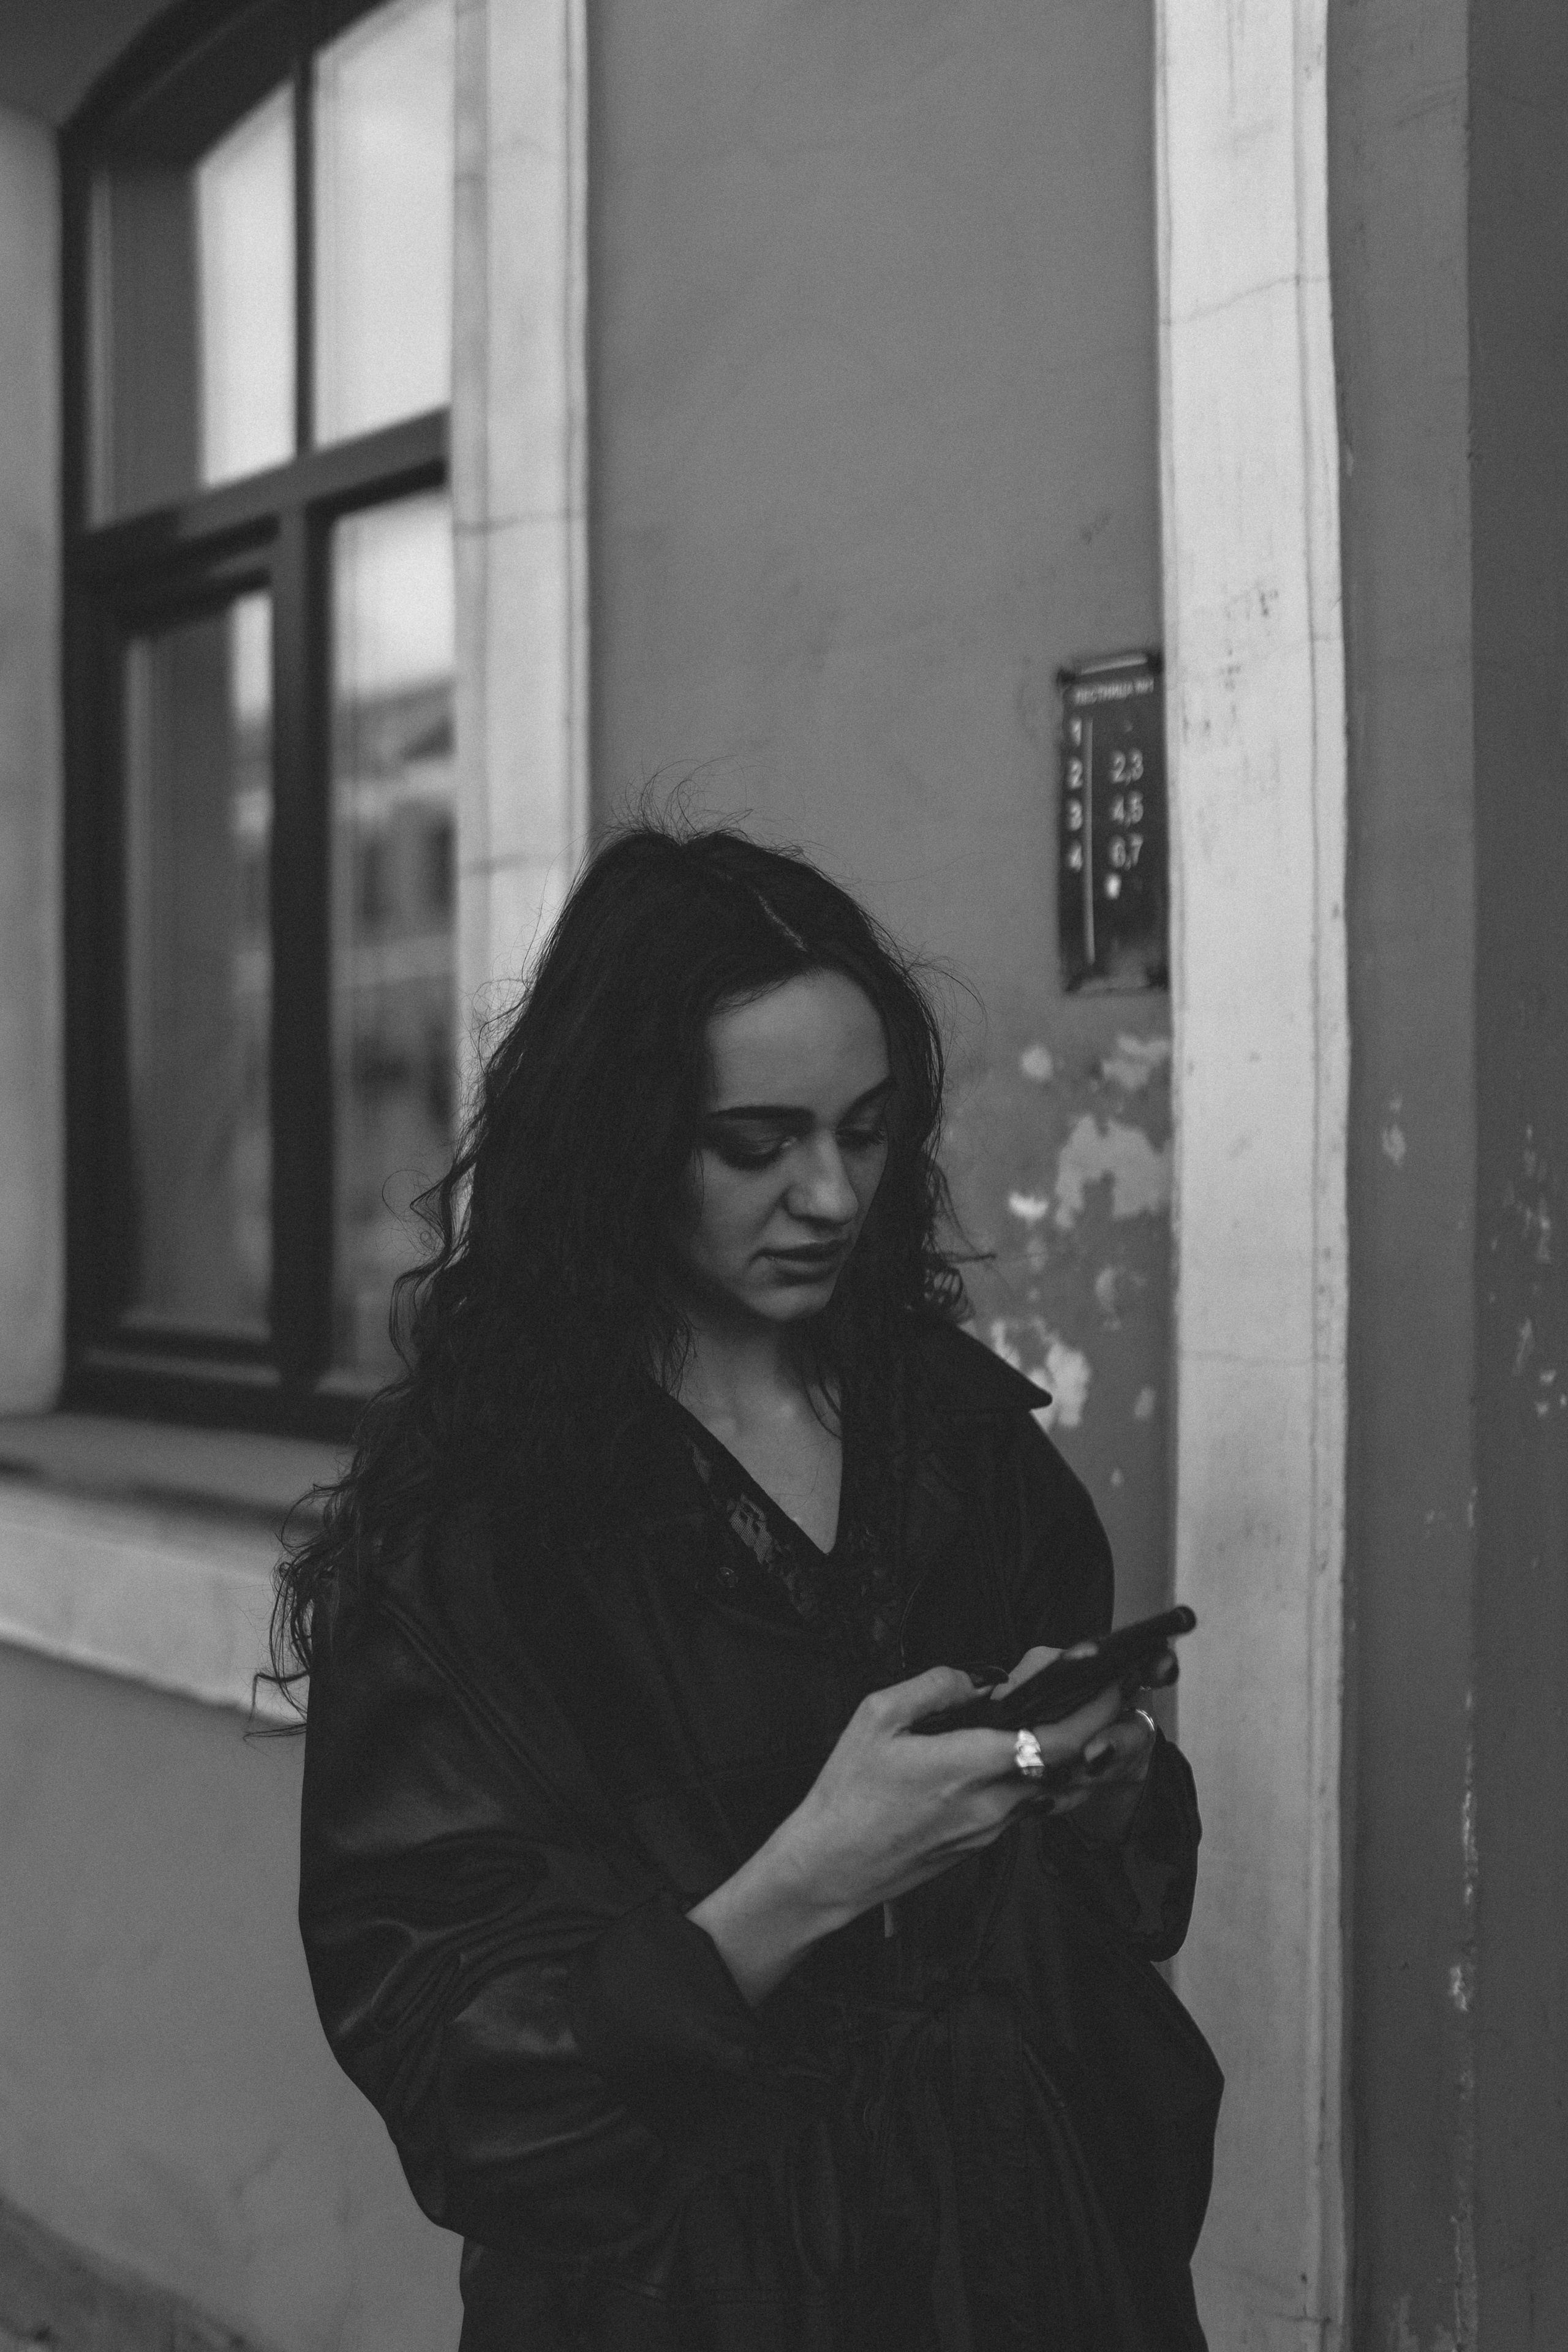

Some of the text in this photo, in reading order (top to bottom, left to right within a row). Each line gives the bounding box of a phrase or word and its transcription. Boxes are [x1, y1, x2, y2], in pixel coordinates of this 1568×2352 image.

[1070, 717, 1082, 747] 1
[1068, 756, 1084, 790] 2
[1068, 799, 1083, 831] 3
[1068, 842, 1083, 871] 4
